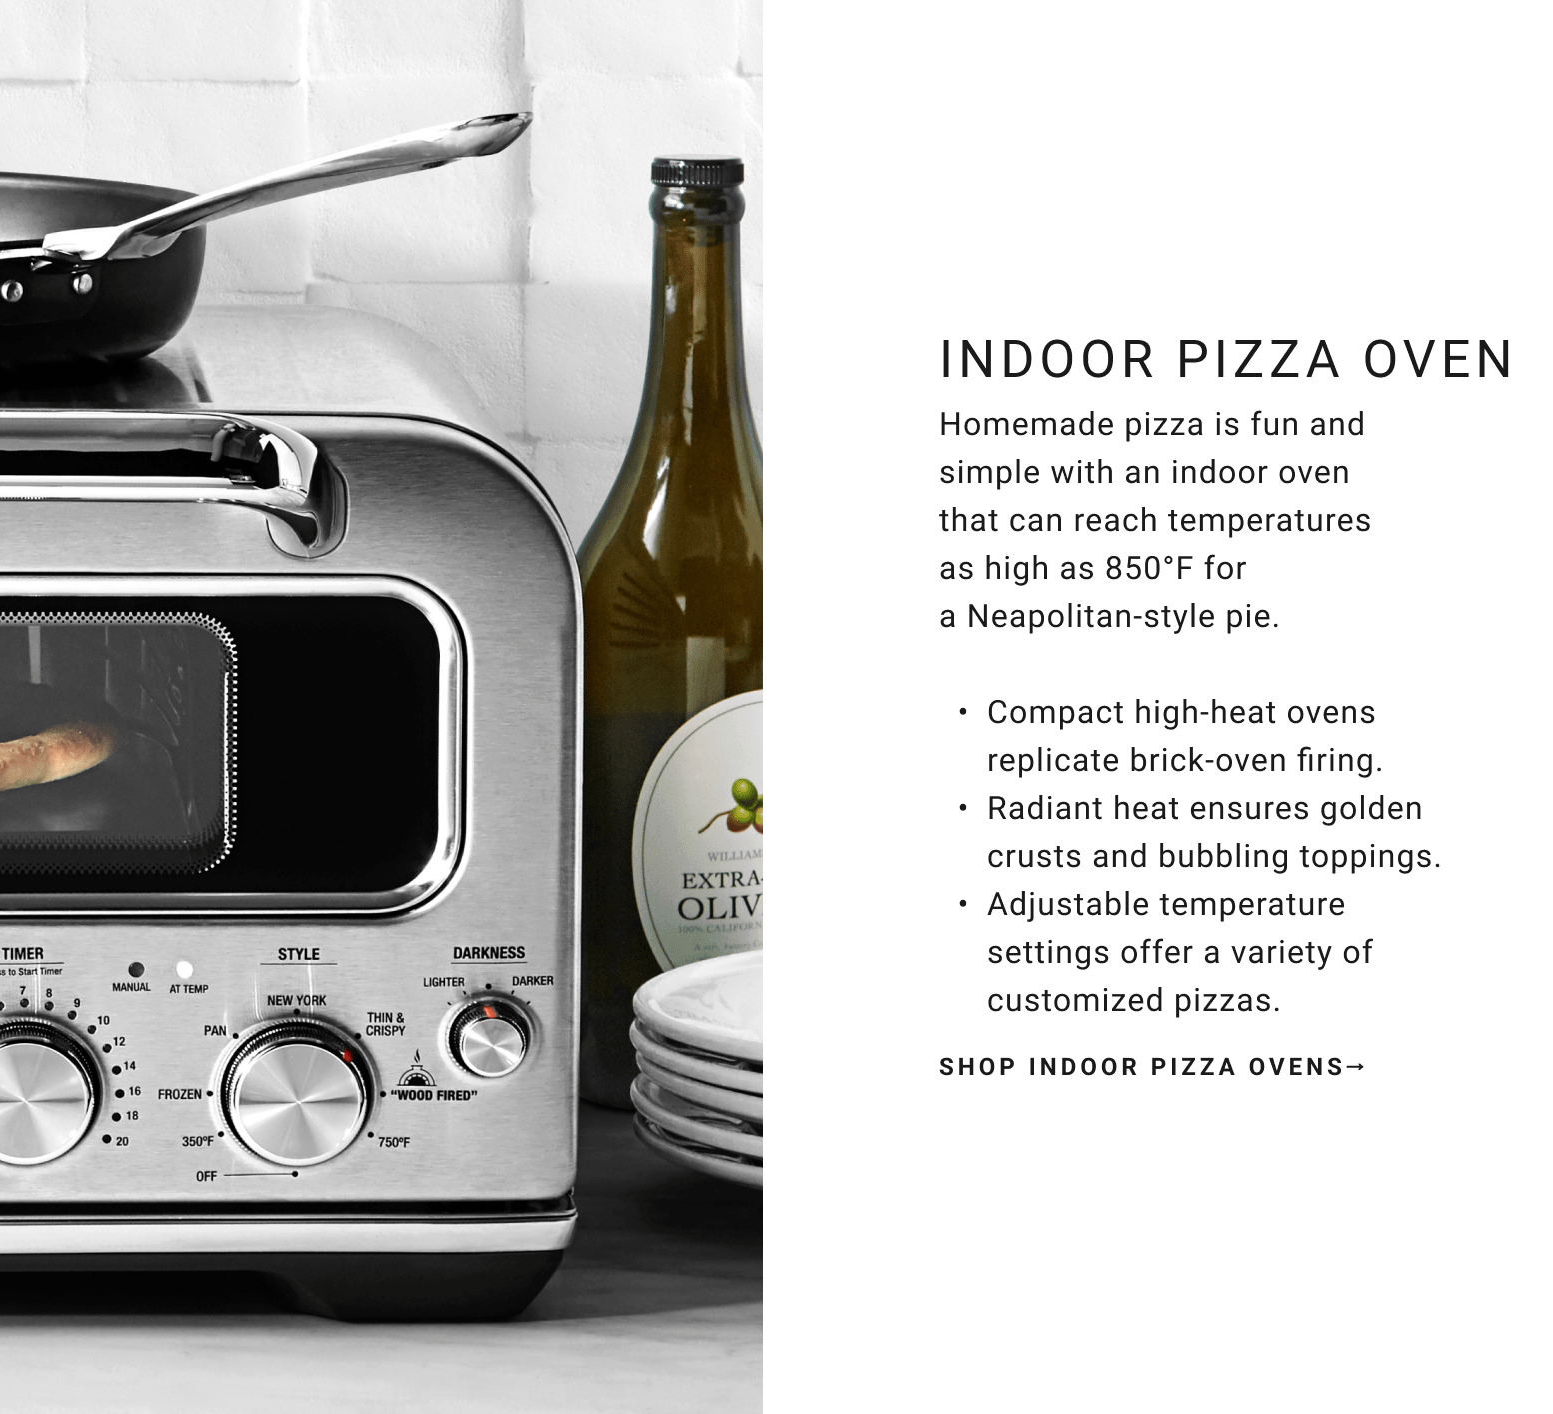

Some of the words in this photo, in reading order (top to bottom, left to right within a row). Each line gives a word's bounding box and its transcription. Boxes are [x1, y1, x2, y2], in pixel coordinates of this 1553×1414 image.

[707, 849, 763, 862] WILLIAM
[677, 893, 763, 921] OLIV
[1, 946, 45, 961] TIMER
[277, 947, 321, 961] STYLE
[452, 945, 527, 961] DARKNESS
[8, 967, 17, 977] to
[18, 967, 38, 977] Start
[39, 966, 63, 977] Timer
[112, 982, 152, 993] MANUAL
[423, 976, 466, 989] LIGHTER
[511, 974, 555, 988] DARKER
[19, 985, 27, 996] 7
[45, 987, 53, 998] 8
[169, 984, 182, 995] AT
[182, 984, 210, 995] TEMP
[73, 997, 81, 1008] 9
[266, 994, 295, 1007] NEW
[295, 994, 328, 1007] YORK
[97, 1015, 110, 1026] 10
[366, 1011, 394, 1024] THIN
[395, 1011, 406, 1024] &
[203, 1024, 228, 1037] PAN
[365, 1024, 407, 1037] CRISPY
[113, 1036, 126, 1047] 12
[123, 1060, 137, 1071] 14
[128, 1085, 142, 1096] 16
[157, 1088, 203, 1101] FROZEN
[126, 1110, 139, 1121] 18
[115, 1136, 129, 1147] 20
[195, 1170, 218, 1183] OFF
